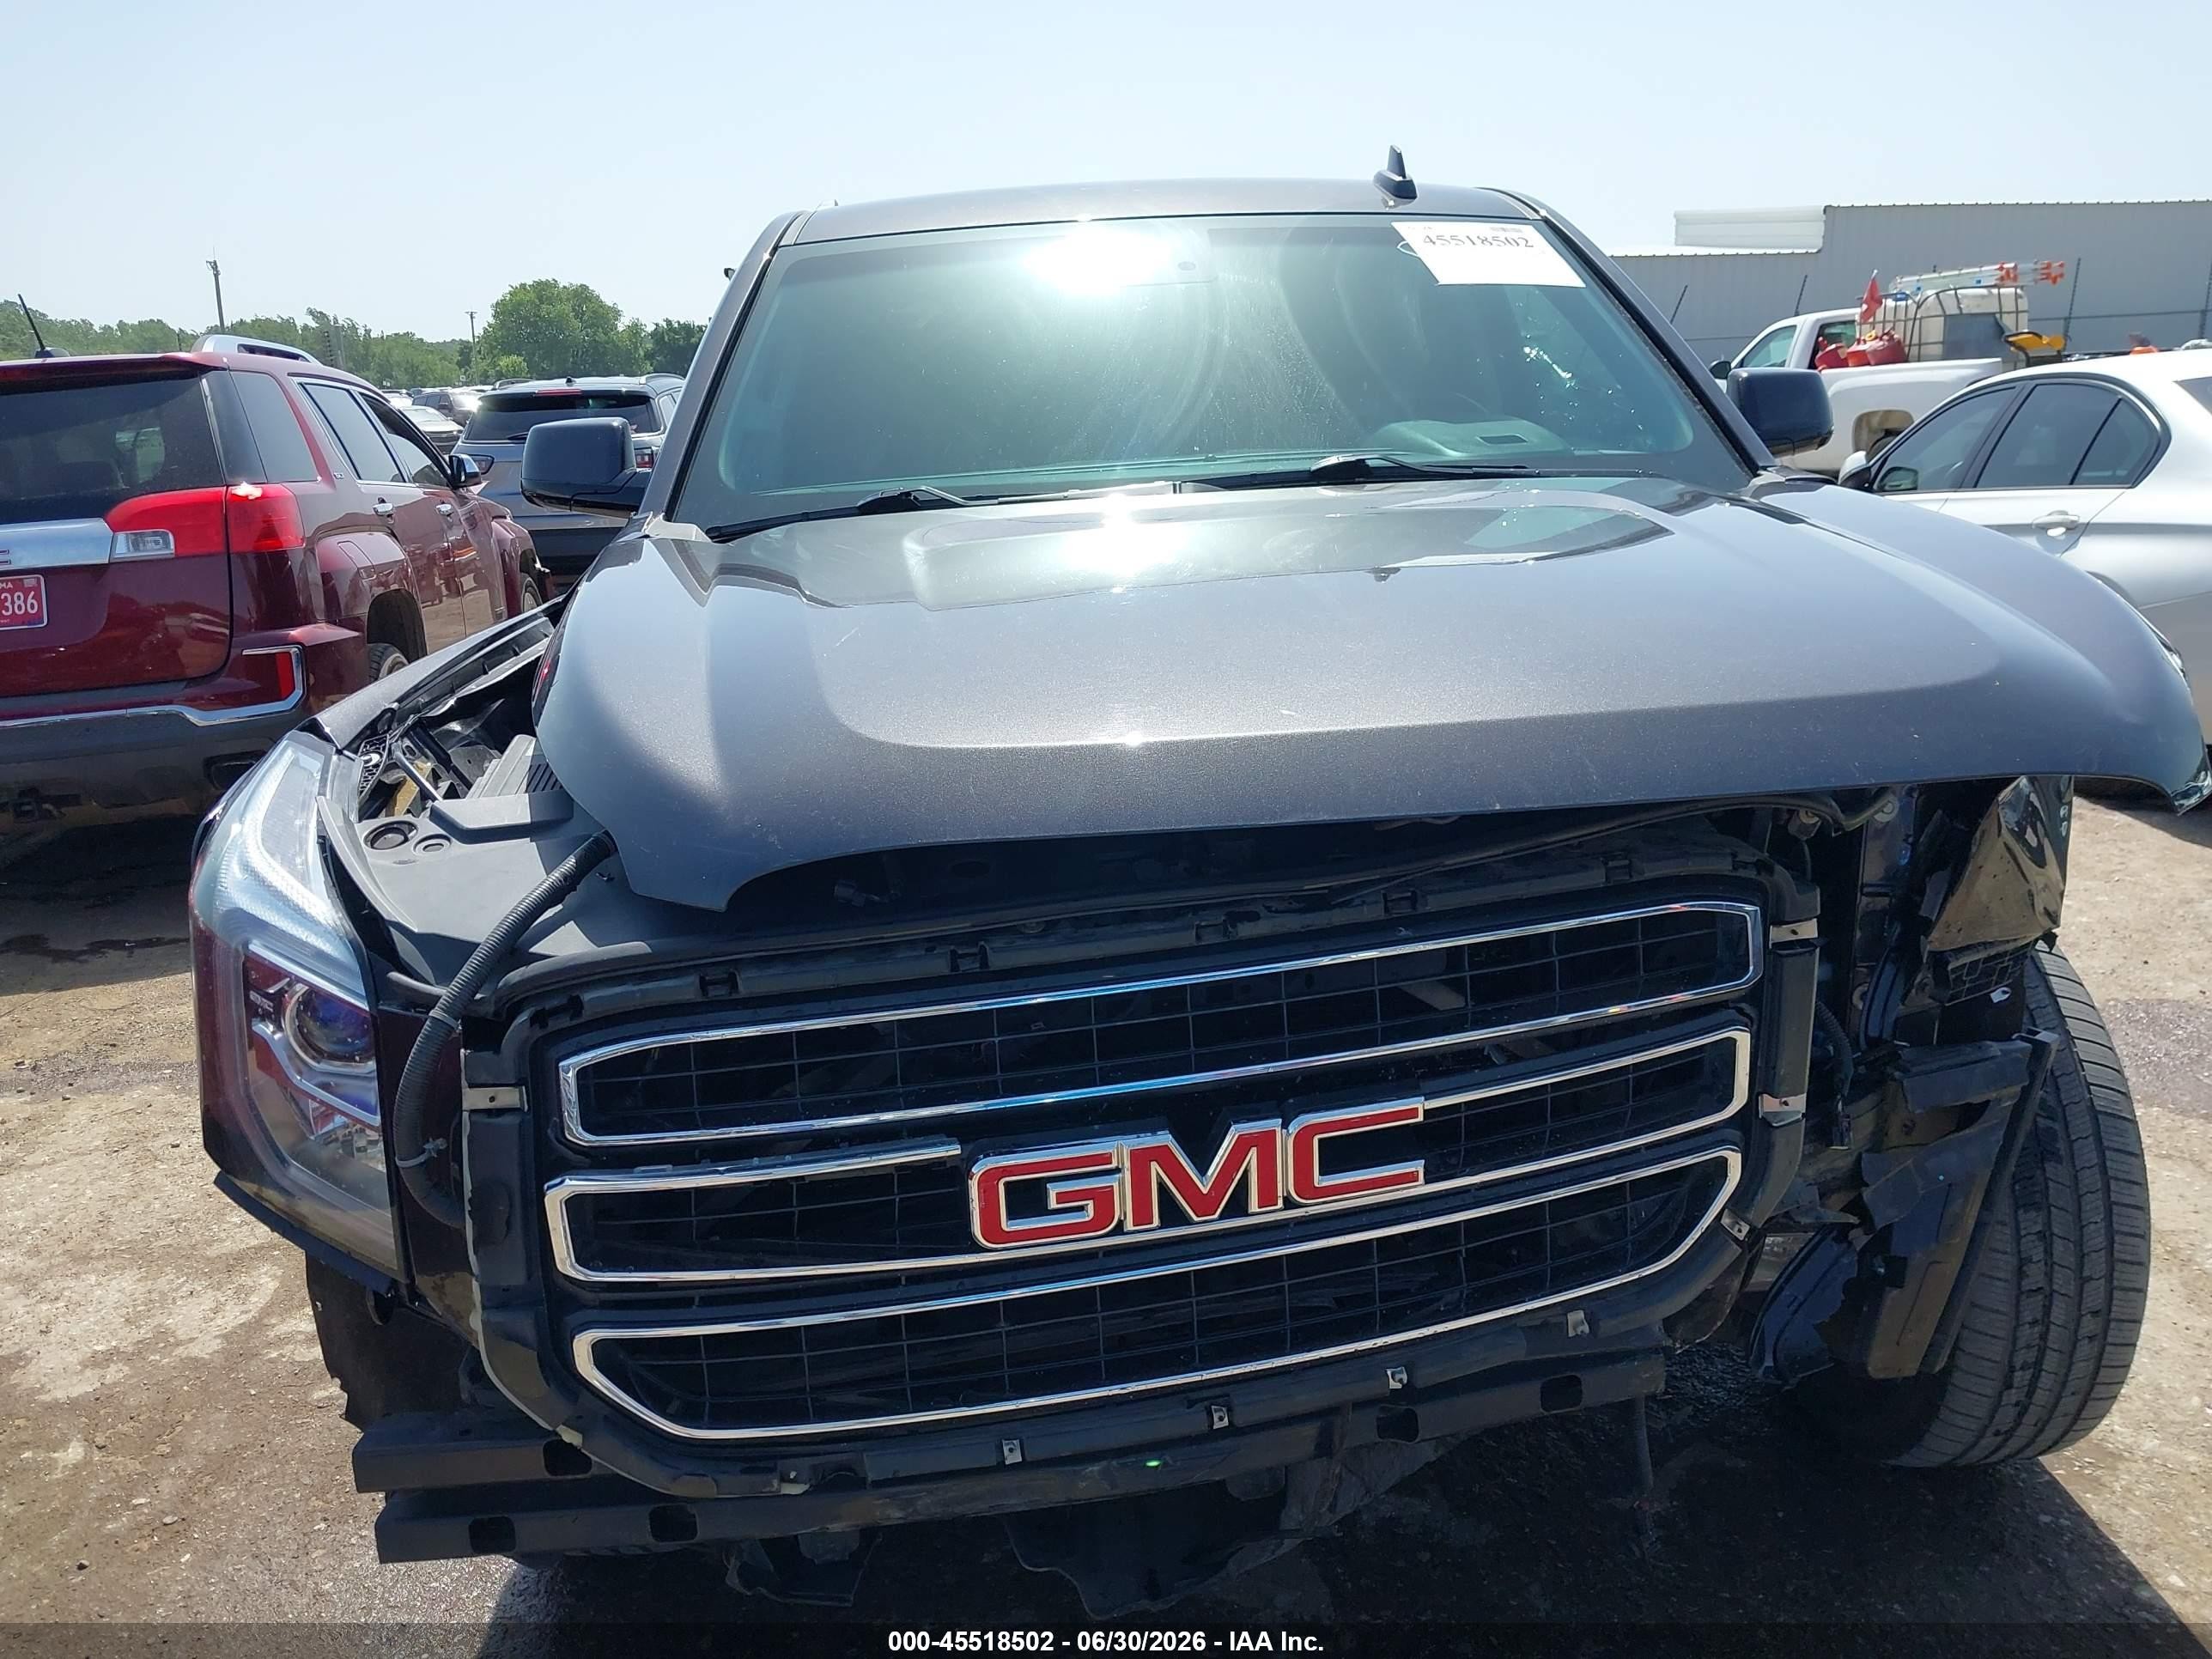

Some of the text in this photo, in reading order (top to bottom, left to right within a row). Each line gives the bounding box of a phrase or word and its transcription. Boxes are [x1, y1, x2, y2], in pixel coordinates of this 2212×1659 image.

[1423, 234, 1534, 248] 45518502
[1, 591, 39, 617] 386
[969, 1097, 1425, 1249] GMC
